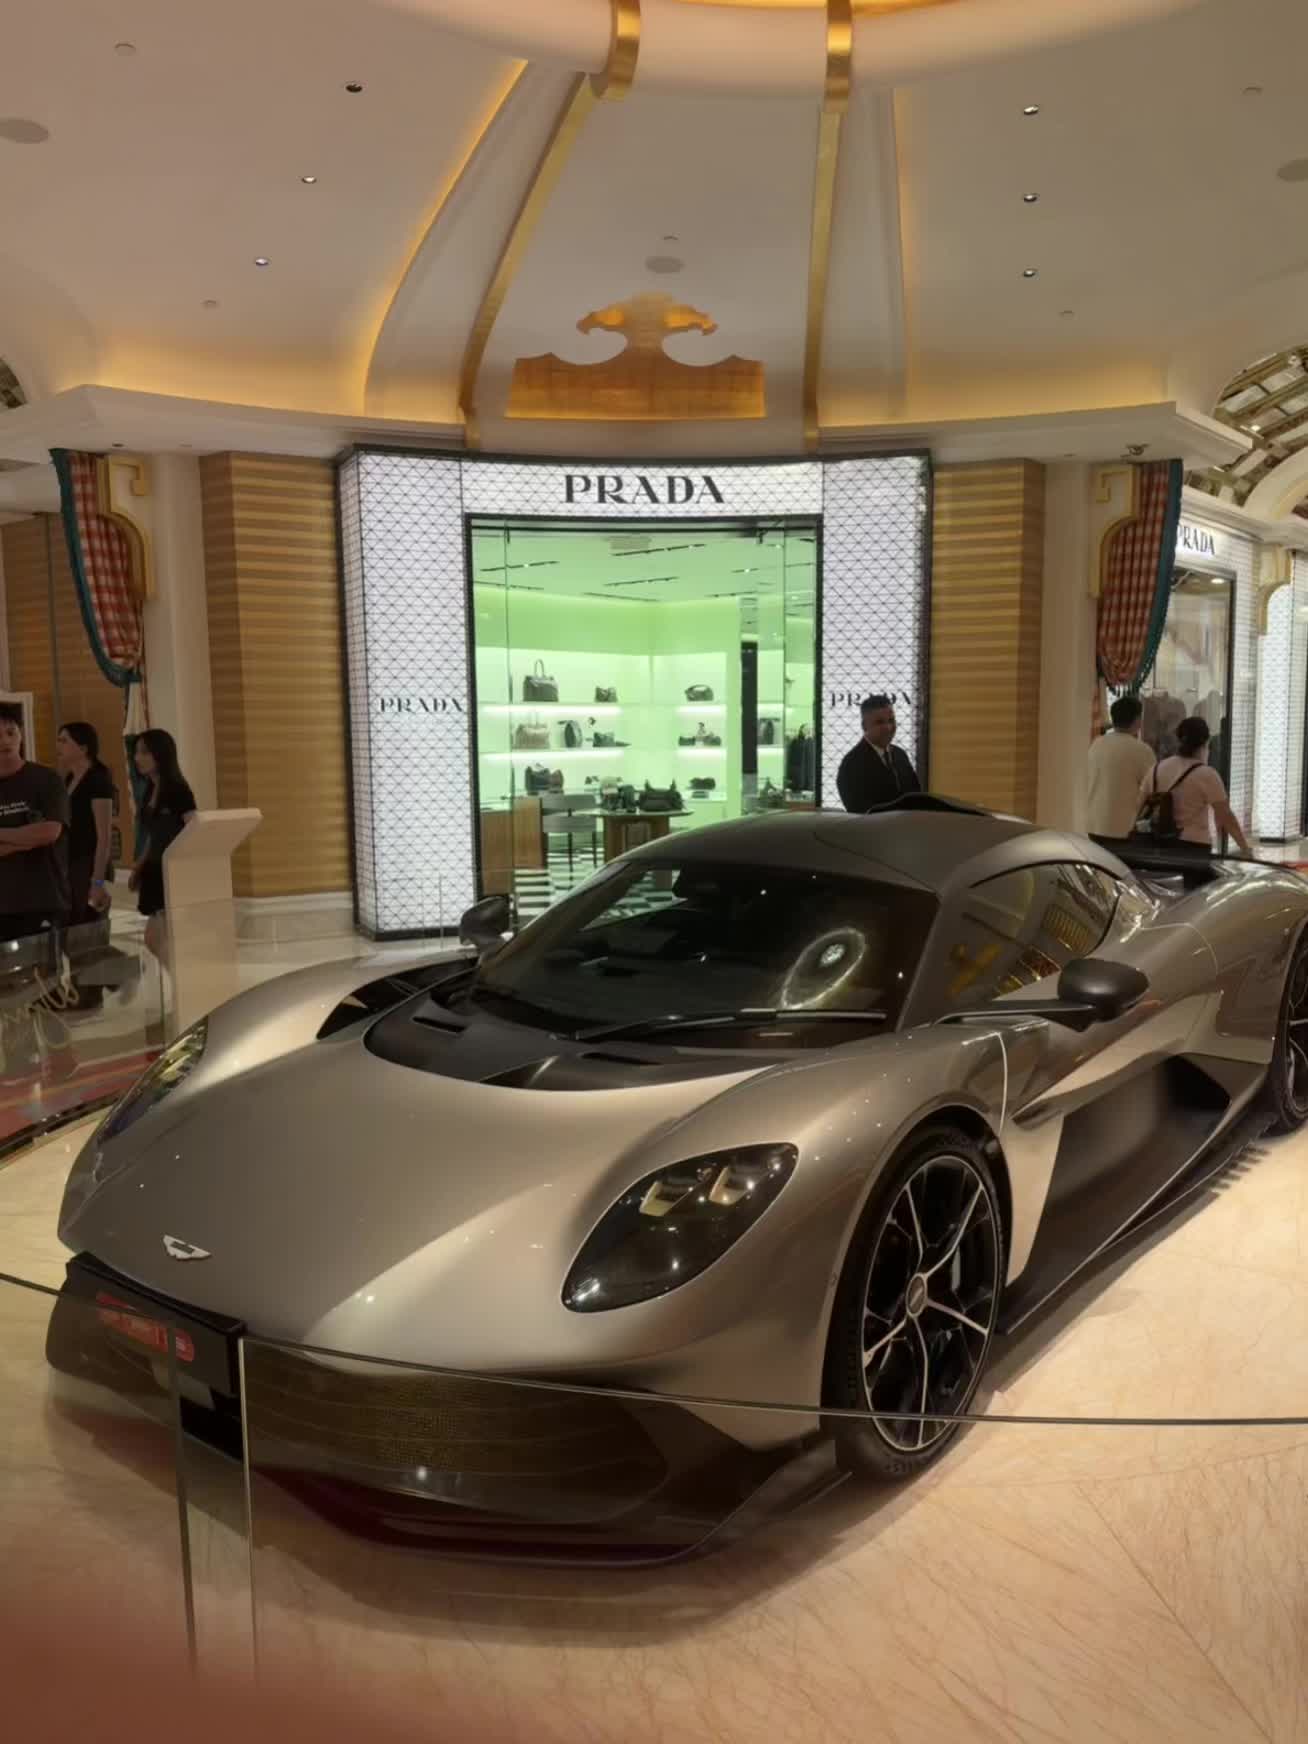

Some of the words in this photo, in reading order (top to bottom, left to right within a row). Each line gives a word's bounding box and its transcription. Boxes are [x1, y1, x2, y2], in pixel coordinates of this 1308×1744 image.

[565, 474, 725, 504] PRADA
[380, 697, 463, 713] PRADA
[831, 691, 911, 706] PRDA
